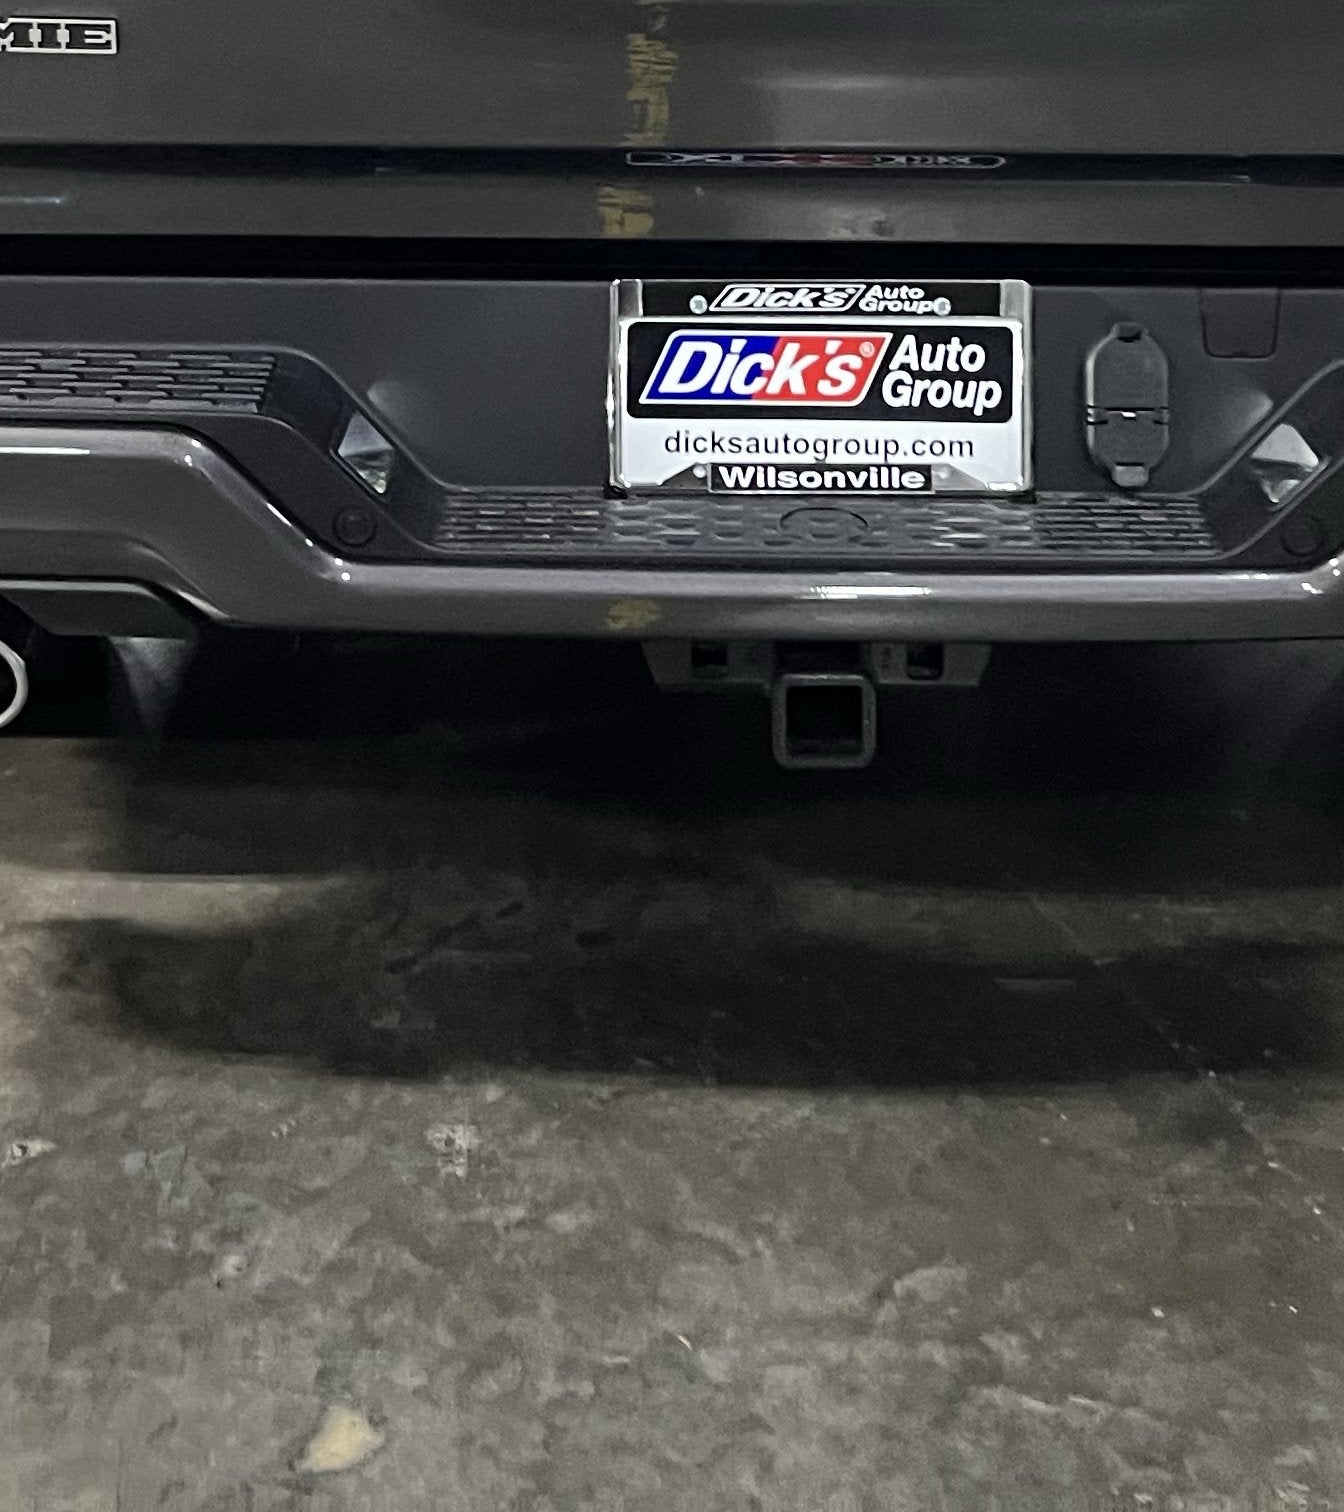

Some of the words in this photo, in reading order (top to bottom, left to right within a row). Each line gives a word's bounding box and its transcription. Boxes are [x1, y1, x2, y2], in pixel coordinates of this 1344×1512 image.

[720, 286, 850, 308] Dick's
[864, 284, 925, 300] Auto
[859, 297, 936, 315] Group
[657, 337, 864, 397] Dick's
[888, 334, 987, 373] Auto
[881, 370, 1003, 417] Group
[664, 429, 975, 464] dicksautogroup.com
[718, 465, 926, 490] Wilsonville
